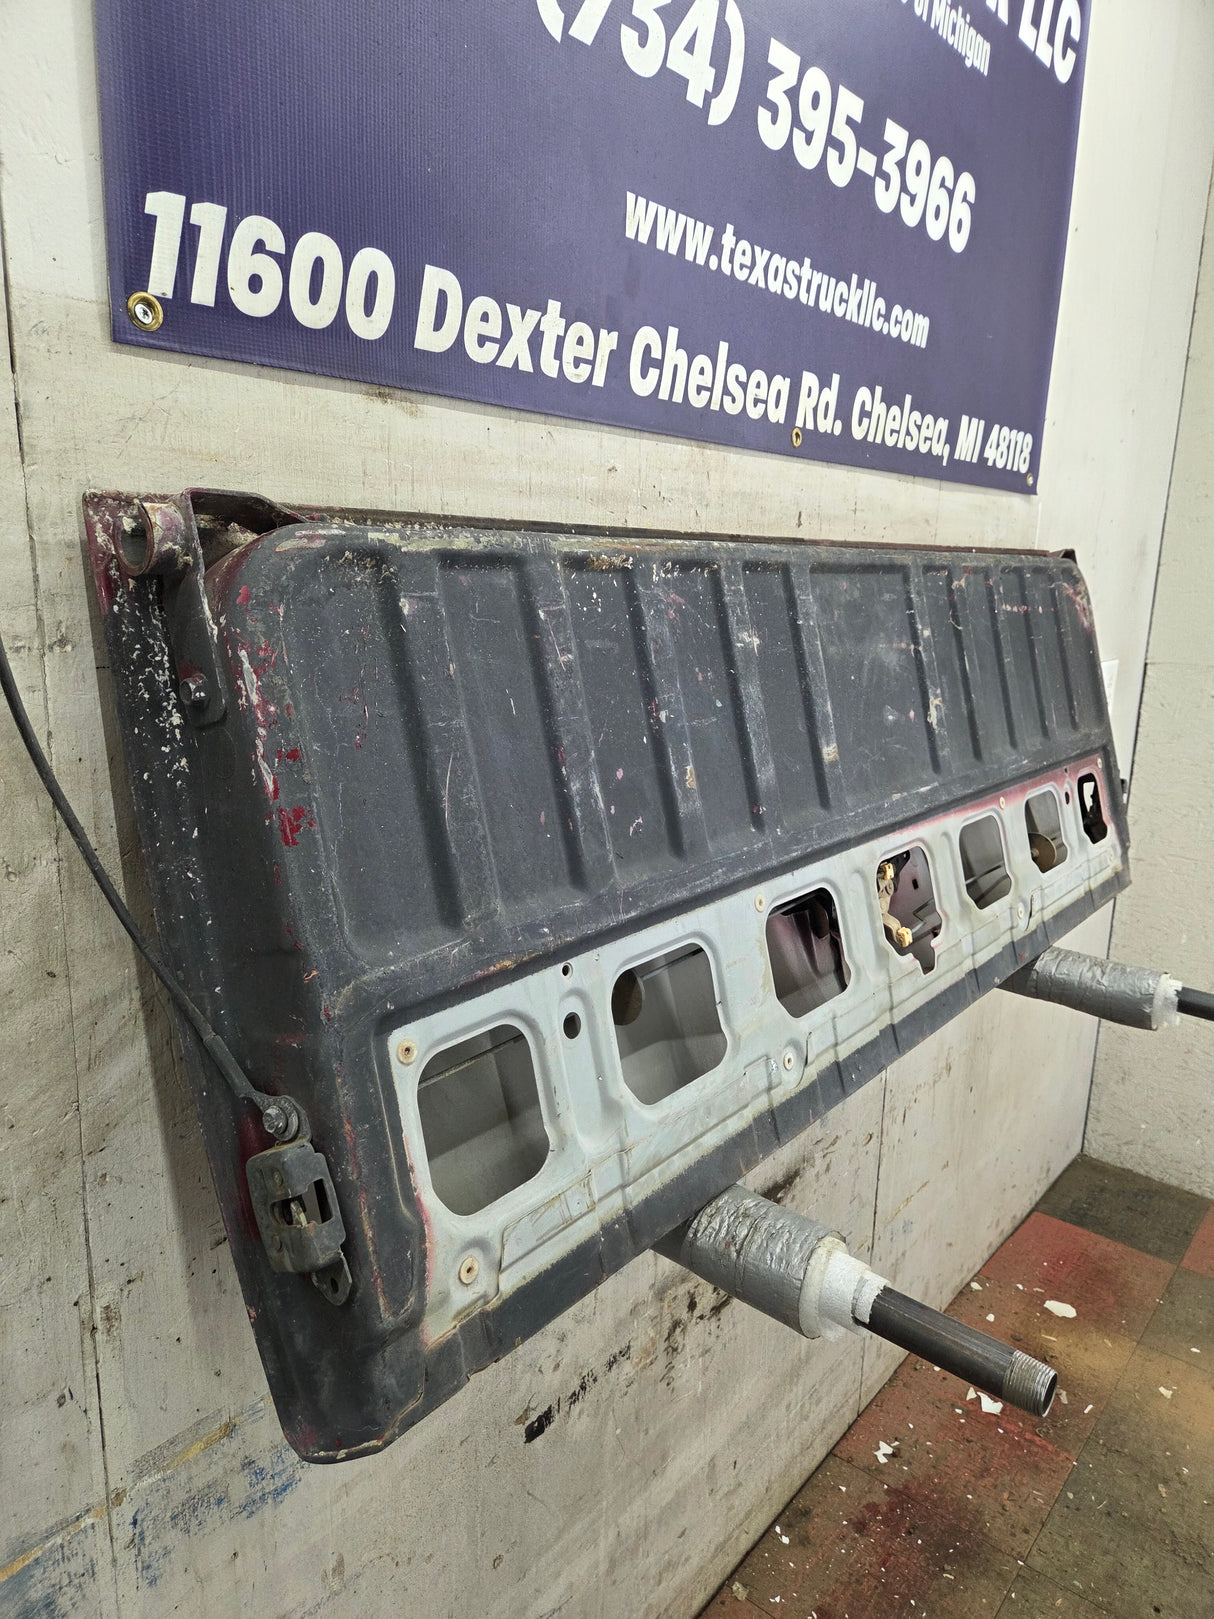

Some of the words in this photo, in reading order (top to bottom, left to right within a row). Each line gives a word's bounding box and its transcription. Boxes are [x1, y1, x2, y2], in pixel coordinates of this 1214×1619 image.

[536, 0, 746, 126] 34)
[757, 36, 976, 254] 395-3966
[930, 0, 991, 77] Michigan
[144, 190, 396, 340] 11600
[413, 263, 619, 388] Dexter
[629, 325, 791, 425] Chelsea
[794, 370, 843, 436] Rd.
[851, 385, 950, 467] Chelsea,
[953, 414, 985, 464] MI
[983, 423, 1033, 474] 48118
[625, 190, 930, 349] www.texastruckllc.com
